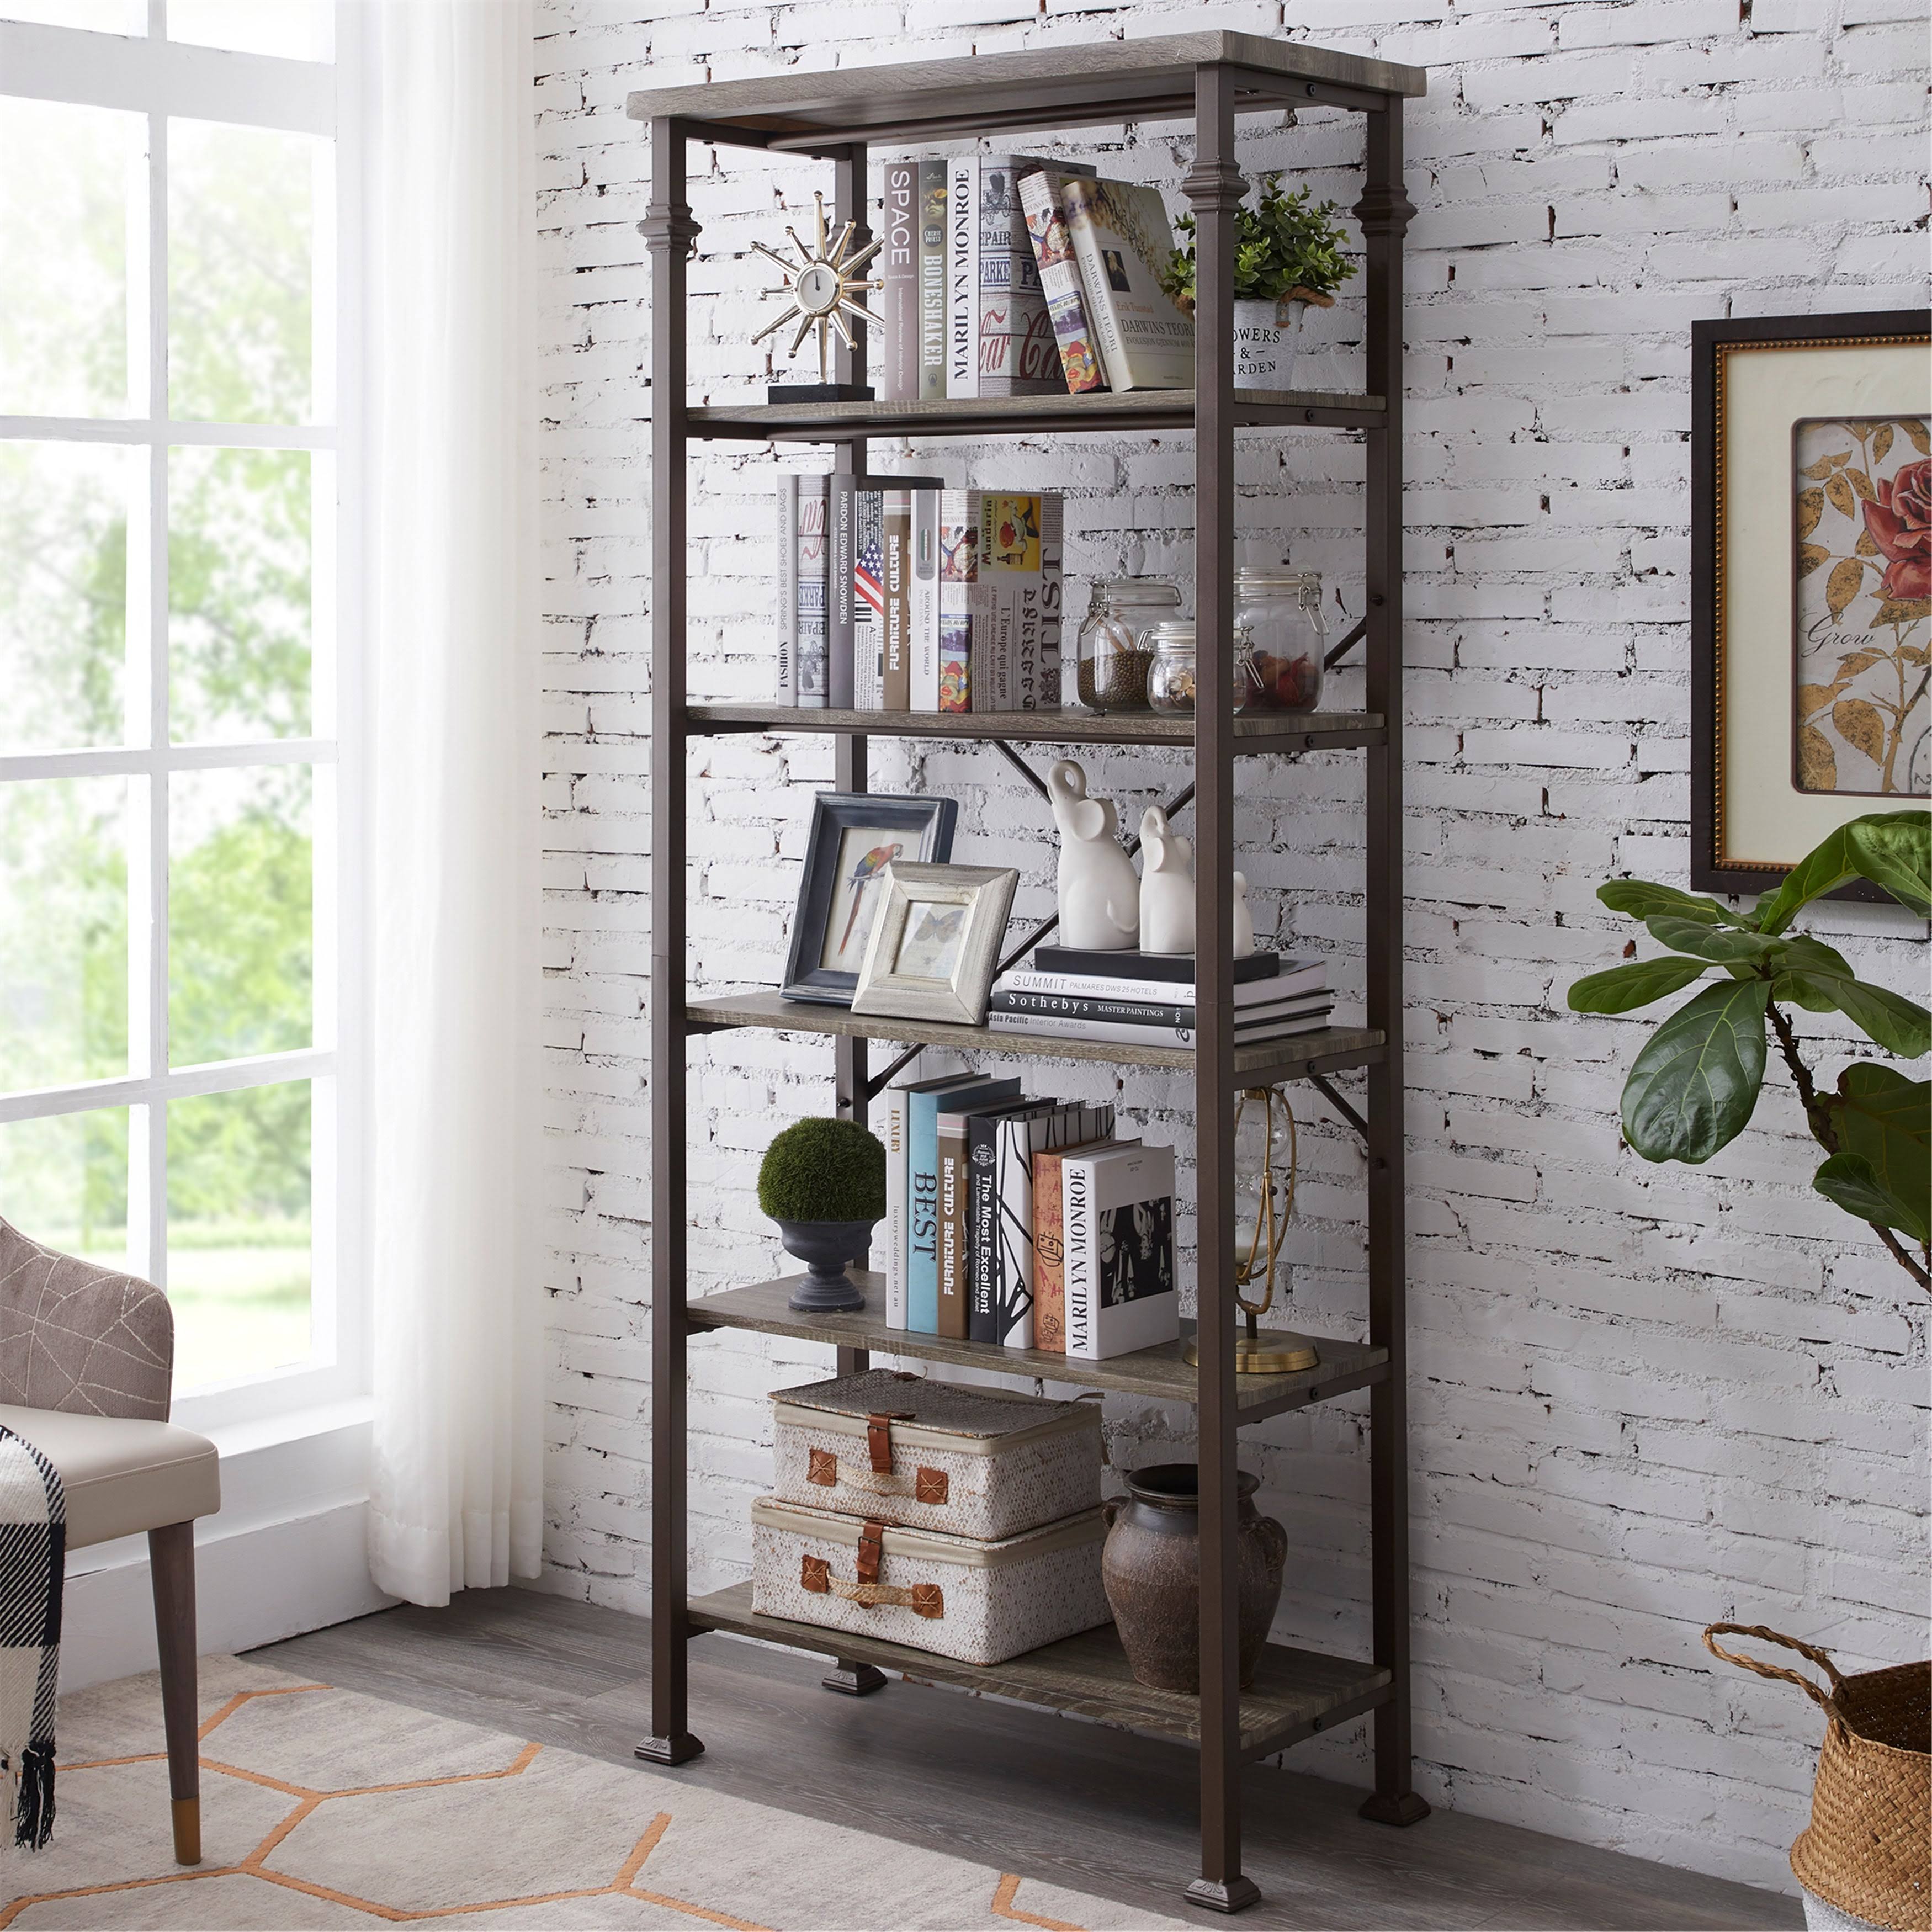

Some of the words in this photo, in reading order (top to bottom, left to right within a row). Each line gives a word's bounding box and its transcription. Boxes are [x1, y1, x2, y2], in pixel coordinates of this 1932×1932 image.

[891, 170, 910, 266] SPACE
[954, 169, 969, 268] MONROE
[924, 254, 943, 366] BONESHAKER
[1086, 253, 1107, 311] DARWINS
[1103, 313, 1118, 351] TEORI
[1116, 301, 1129, 311] Erik
[954, 274, 969, 380] MARILYN
[1121, 319, 1166, 335] DARWINS
[1165, 322, 1195, 336] TEORI
[1125, 337, 1156, 347] EVOLUSJON
[1233, 361, 1276, 374] RDEN
[1240, 347, 1251, 359] &
[840, 491, 848, 530] PARDON
[981, 500, 992, 565] Mandarin
[889, 535, 899, 592] CULTURE
[1041, 548, 1061, 663] TIST
[889, 598, 900, 670] FURNITURE
[1798, 611, 1875, 657] Grow
[780, 641, 788, 687] FASHION
[997, 654, 1009, 669] qui
[997, 672, 1007, 699] gagne
[1009, 993, 1089, 1014] Sothebys
[1097, 1005, 1126, 1014] MASTER
[1126, 1007, 1164, 1017] PAINTINGS
[1013, 975, 1067, 989] SUMMIT
[1069, 982, 1105, 991] PALMARES
[1106, 985, 1121, 993] DWS
[1131, 987, 1158, 995] HOTELS
[989, 1013, 1003, 1022] Asia
[1005, 1015, 1028, 1024] Pacific
[1029, 1017, 1055, 1027] Interior
[1058, 1020, 1086, 1029] Awards
[891, 1110, 900, 1154] LUXURY
[944, 1157, 954, 1216] CULTURE
[981, 1175, 992, 1202] The
[913, 1171, 937, 1263] BEST
[981, 1206, 991, 1242] Most
[1069, 1169, 1087, 1255] MONROE
[944, 1221, 954, 1296] FURNITURE
[980, 1246, 991, 1314] Excellent
[1071, 1259, 1087, 1351] MARILYN
